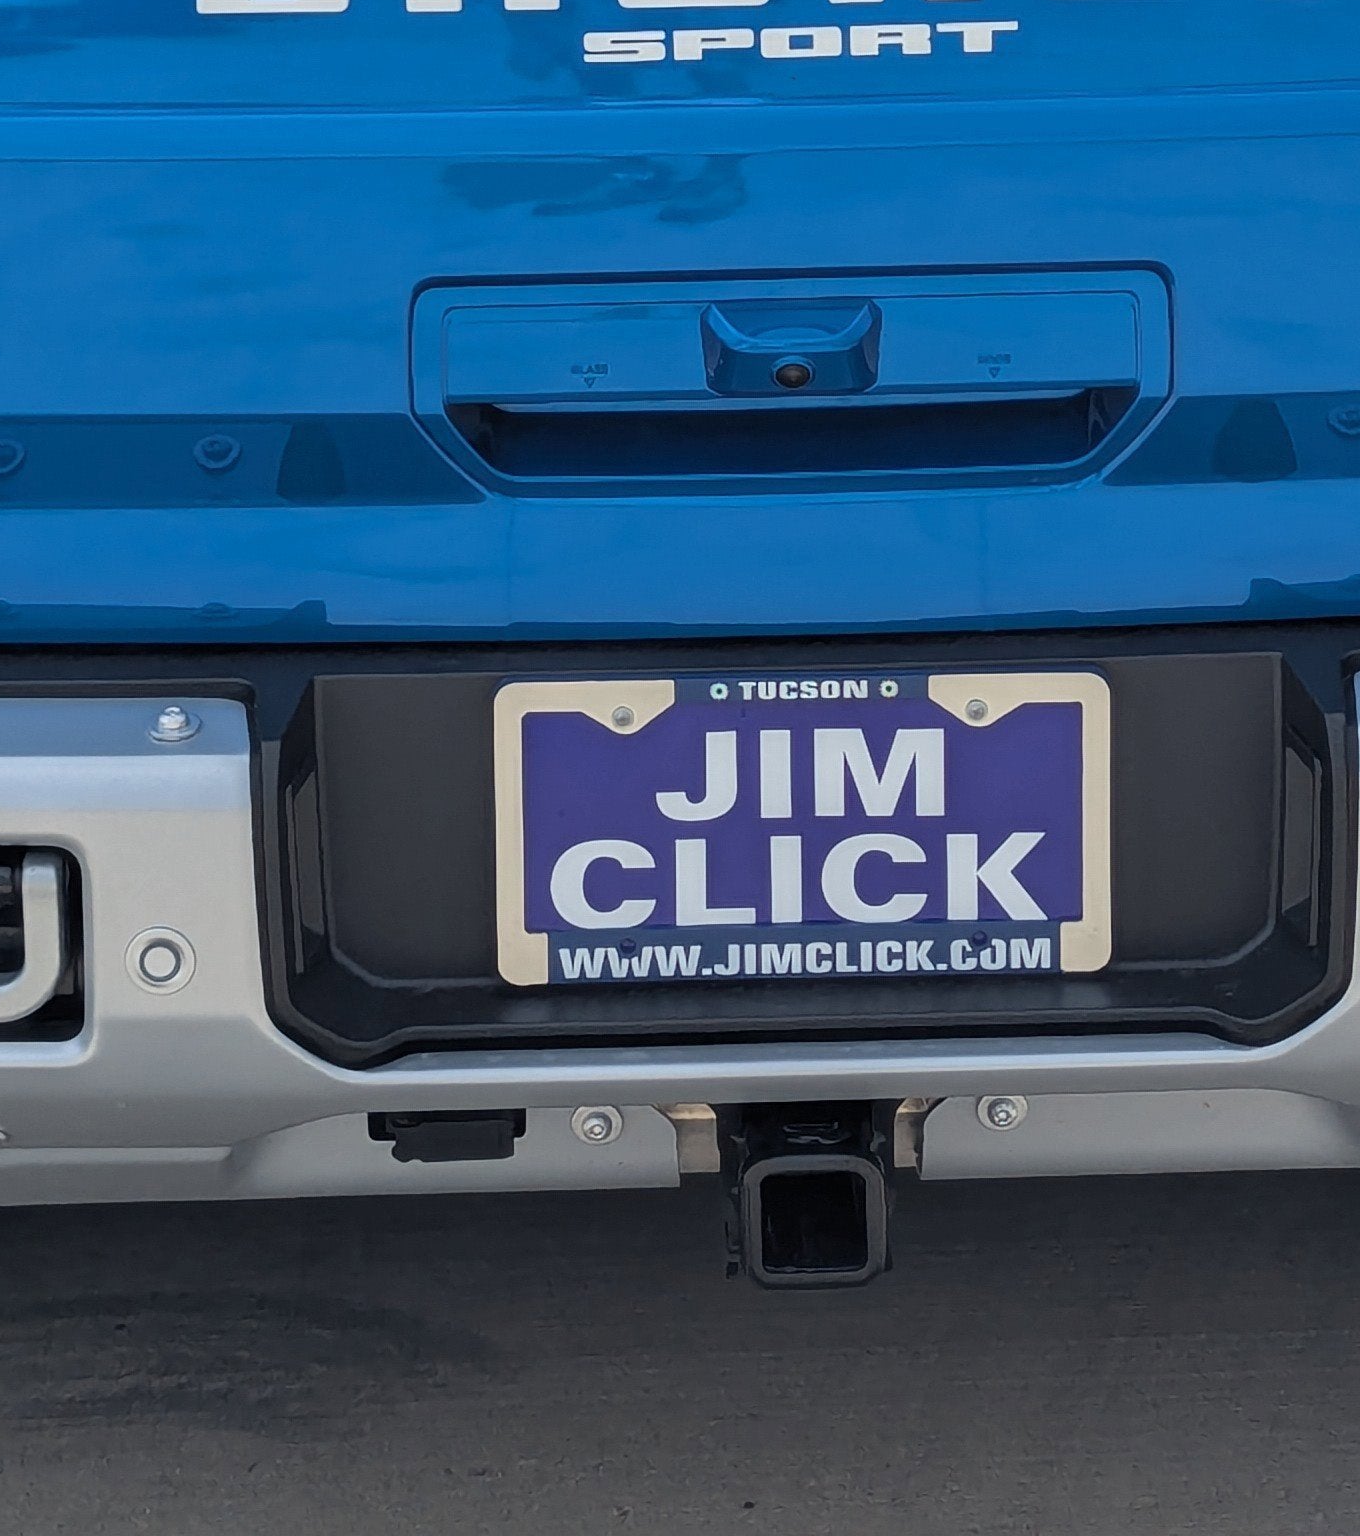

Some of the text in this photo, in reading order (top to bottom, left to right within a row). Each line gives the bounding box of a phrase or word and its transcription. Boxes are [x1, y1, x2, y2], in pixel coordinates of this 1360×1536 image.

[582, 20, 1019, 64] SPORT
[738, 679, 870, 701] TUCSON
[655, 727, 945, 822] JIM
[549, 831, 1049, 930] CLICK
[558, 937, 1052, 979] WWW.JIMCLICK.COM
